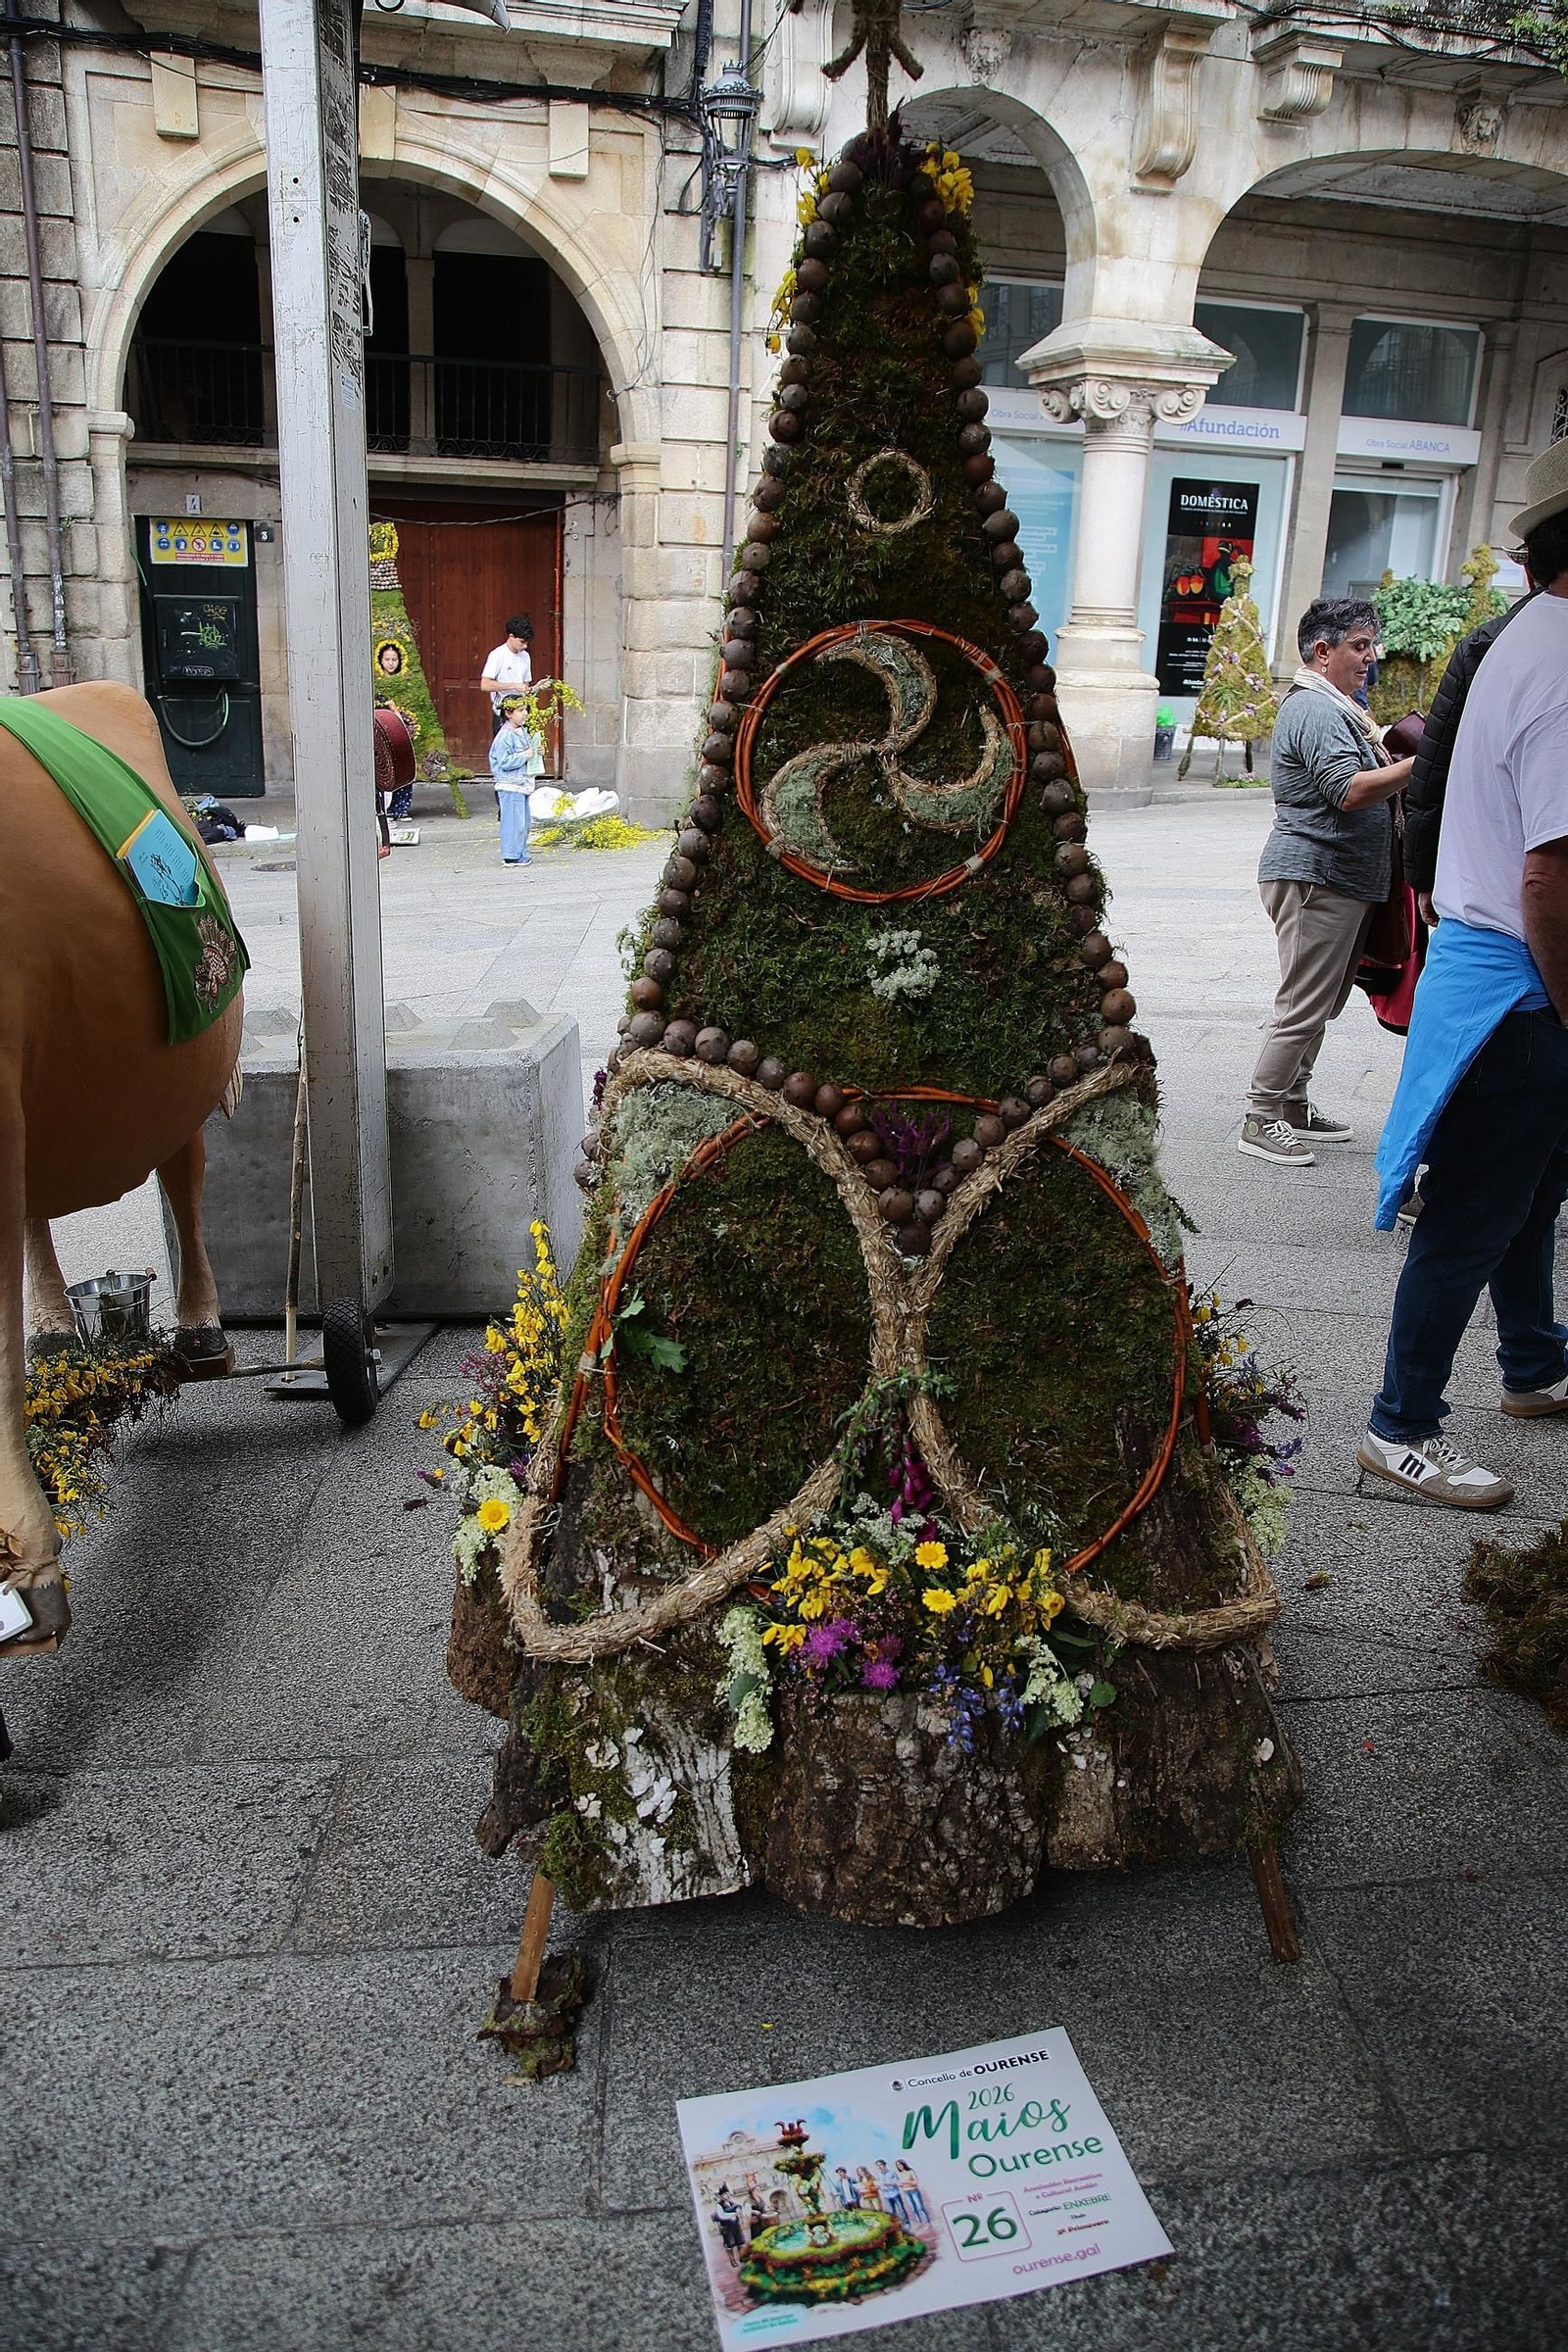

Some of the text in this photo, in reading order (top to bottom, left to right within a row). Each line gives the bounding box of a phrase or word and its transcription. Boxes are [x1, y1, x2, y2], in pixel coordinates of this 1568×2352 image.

[1366, 438, 1450, 452] Obra Social ABANCA
[1180, 493, 1249, 510] DOMÉSTICA
[261, 530, 269, 541] 3
[908, 2049, 1050, 2087] Concello de OURENSE
[968, 2082, 1014, 2110] 2026
[902, 2098, 1071, 2160] Maios
[968, 2136, 1103, 2178] Ourense
[1062, 2192, 1111, 2209] ENXEBRE
[952, 2206, 1018, 2248] 26
[1012, 2242, 1101, 2275] ourense.gal
